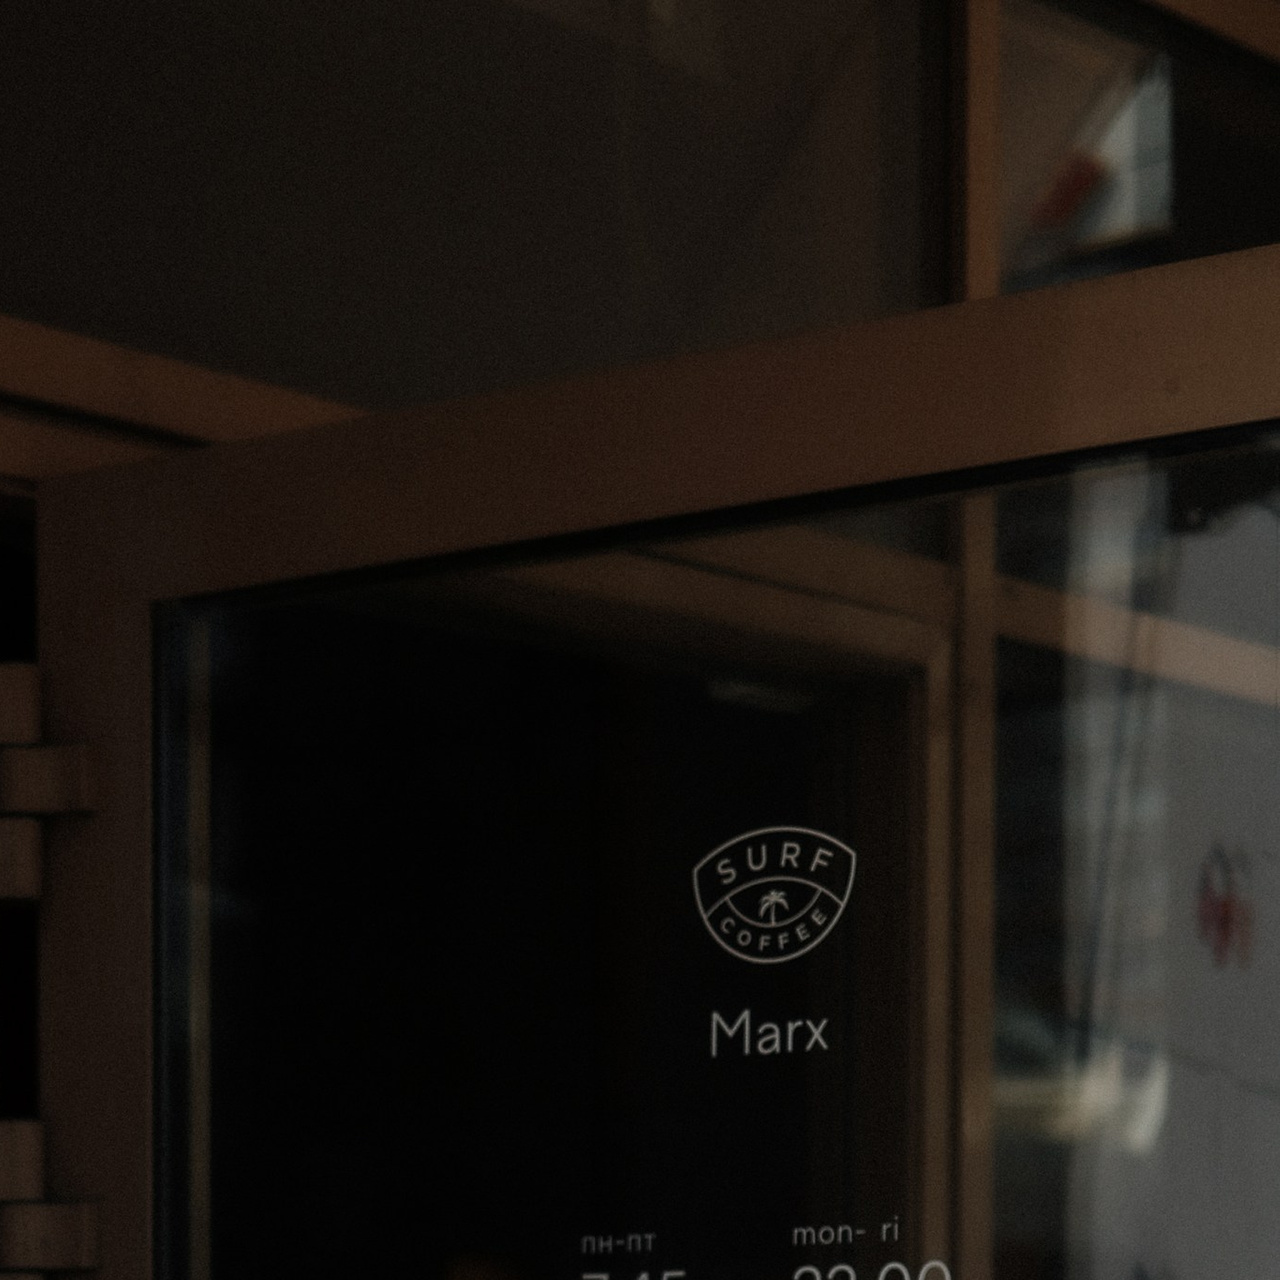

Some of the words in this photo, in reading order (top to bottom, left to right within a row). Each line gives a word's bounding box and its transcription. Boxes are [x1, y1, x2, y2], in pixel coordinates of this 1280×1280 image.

[716, 842, 834, 885] SURF
[720, 908, 828, 951] COFFEE
[710, 1008, 829, 1058] Marx
[580, 1231, 658, 1255] пн-пт
